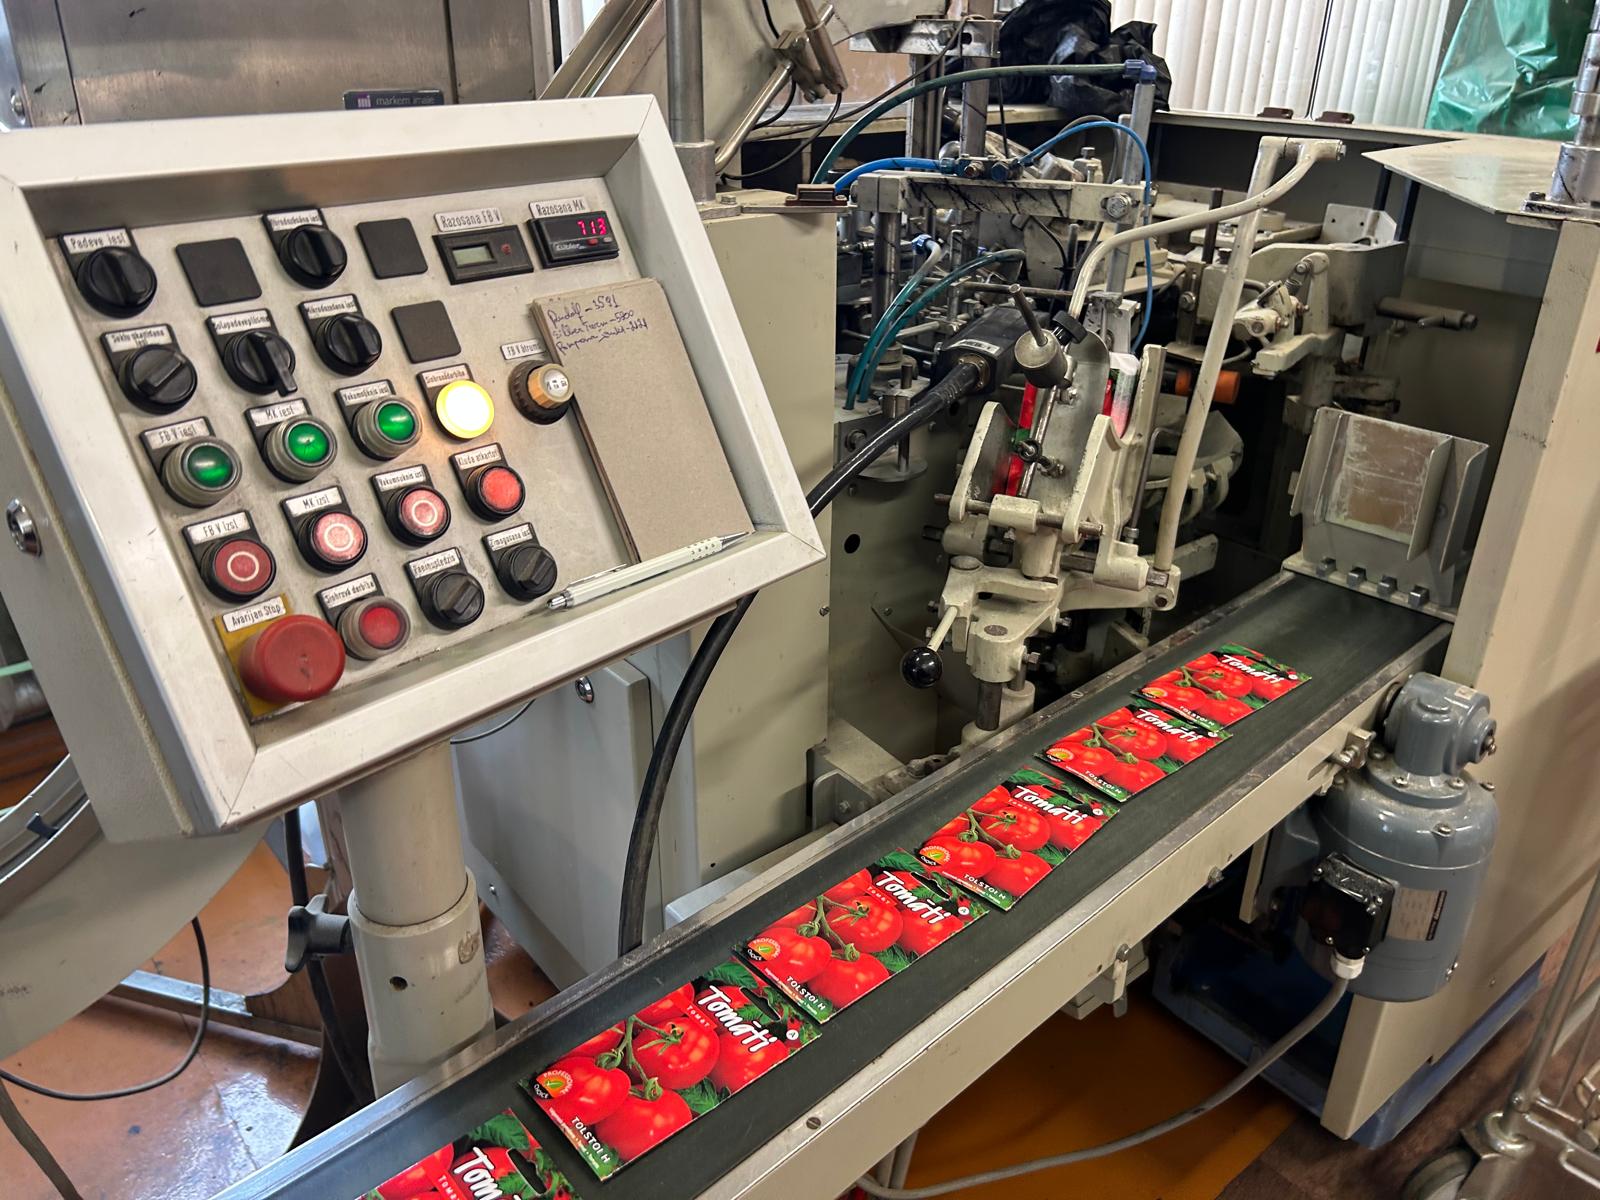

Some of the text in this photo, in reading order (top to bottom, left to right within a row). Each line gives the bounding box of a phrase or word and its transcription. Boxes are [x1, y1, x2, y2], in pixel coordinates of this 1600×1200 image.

[376, 96, 412, 106] markem
[572, 199, 586, 211] MK
[481, 209, 494, 223] FB
[493, 208, 501, 222] V
[577, 217, 607, 236] 713
[70, 236, 104, 249] Padeve
[265, 409, 279, 420] MK
[159, 430, 171, 443] FB
[171, 427, 178, 440] V
[302, 498, 315, 509] MK
[203, 524, 215, 537] FB
[215, 522, 222, 534] V
[263, 604, 281, 617] Stop
[1136, 708, 1203, 742] Tomāti
[1014, 785, 1088, 825] Tomāti
[964, 873, 999, 895] TOLSTOI
[876, 870, 952, 924] Tomāti
[786, 975, 818, 1004] TOLSTOI
[698, 985, 778, 1052] Tomāti
[571, 1116, 604, 1154] TOLSTOI
